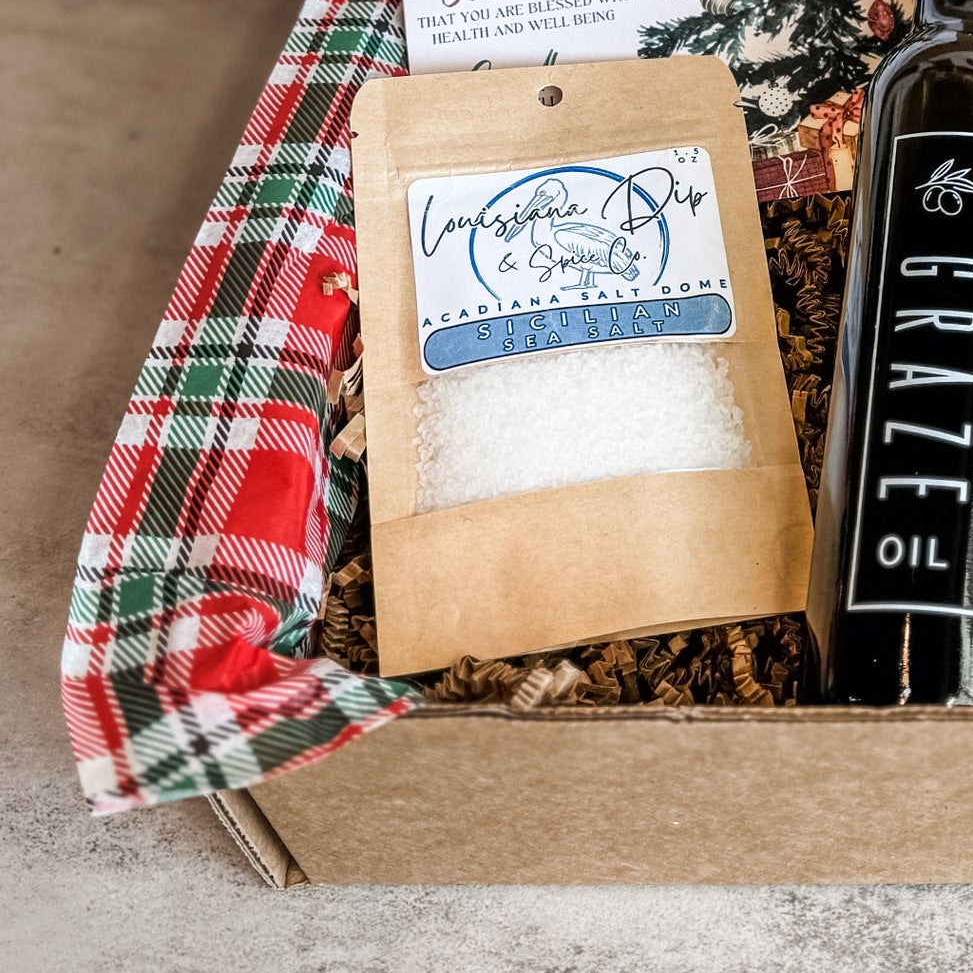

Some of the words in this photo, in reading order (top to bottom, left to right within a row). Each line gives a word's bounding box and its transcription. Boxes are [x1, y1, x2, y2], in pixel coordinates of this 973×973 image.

[417, 13, 456, 29] THAT
[460, 8, 491, 23] YOU
[495, 3, 524, 19] ARE
[432, 27, 490, 45] HEALTH
[494, 22, 524, 37] AND
[528, 9, 616, 31] WELL-BEING
[673, 147, 700, 156] 1.5
[678, 156, 698, 164] OZ
[421, 194, 589, 257] Louisiana
[601, 166, 708, 235] Dip
[498, 252, 518, 273] &
[528, 244, 601, 283] Spice
[608, 236, 647, 275] Co.
[422, 294, 560, 328] ACADIANA
[581, 287, 641, 301] SALT
[661, 279, 728, 295] DOME
[477, 302, 681, 340] SICILIAN
[502, 330, 568, 352] SEA
[588, 320, 665, 338] SALT
[876, 534, 950, 570] OIL
